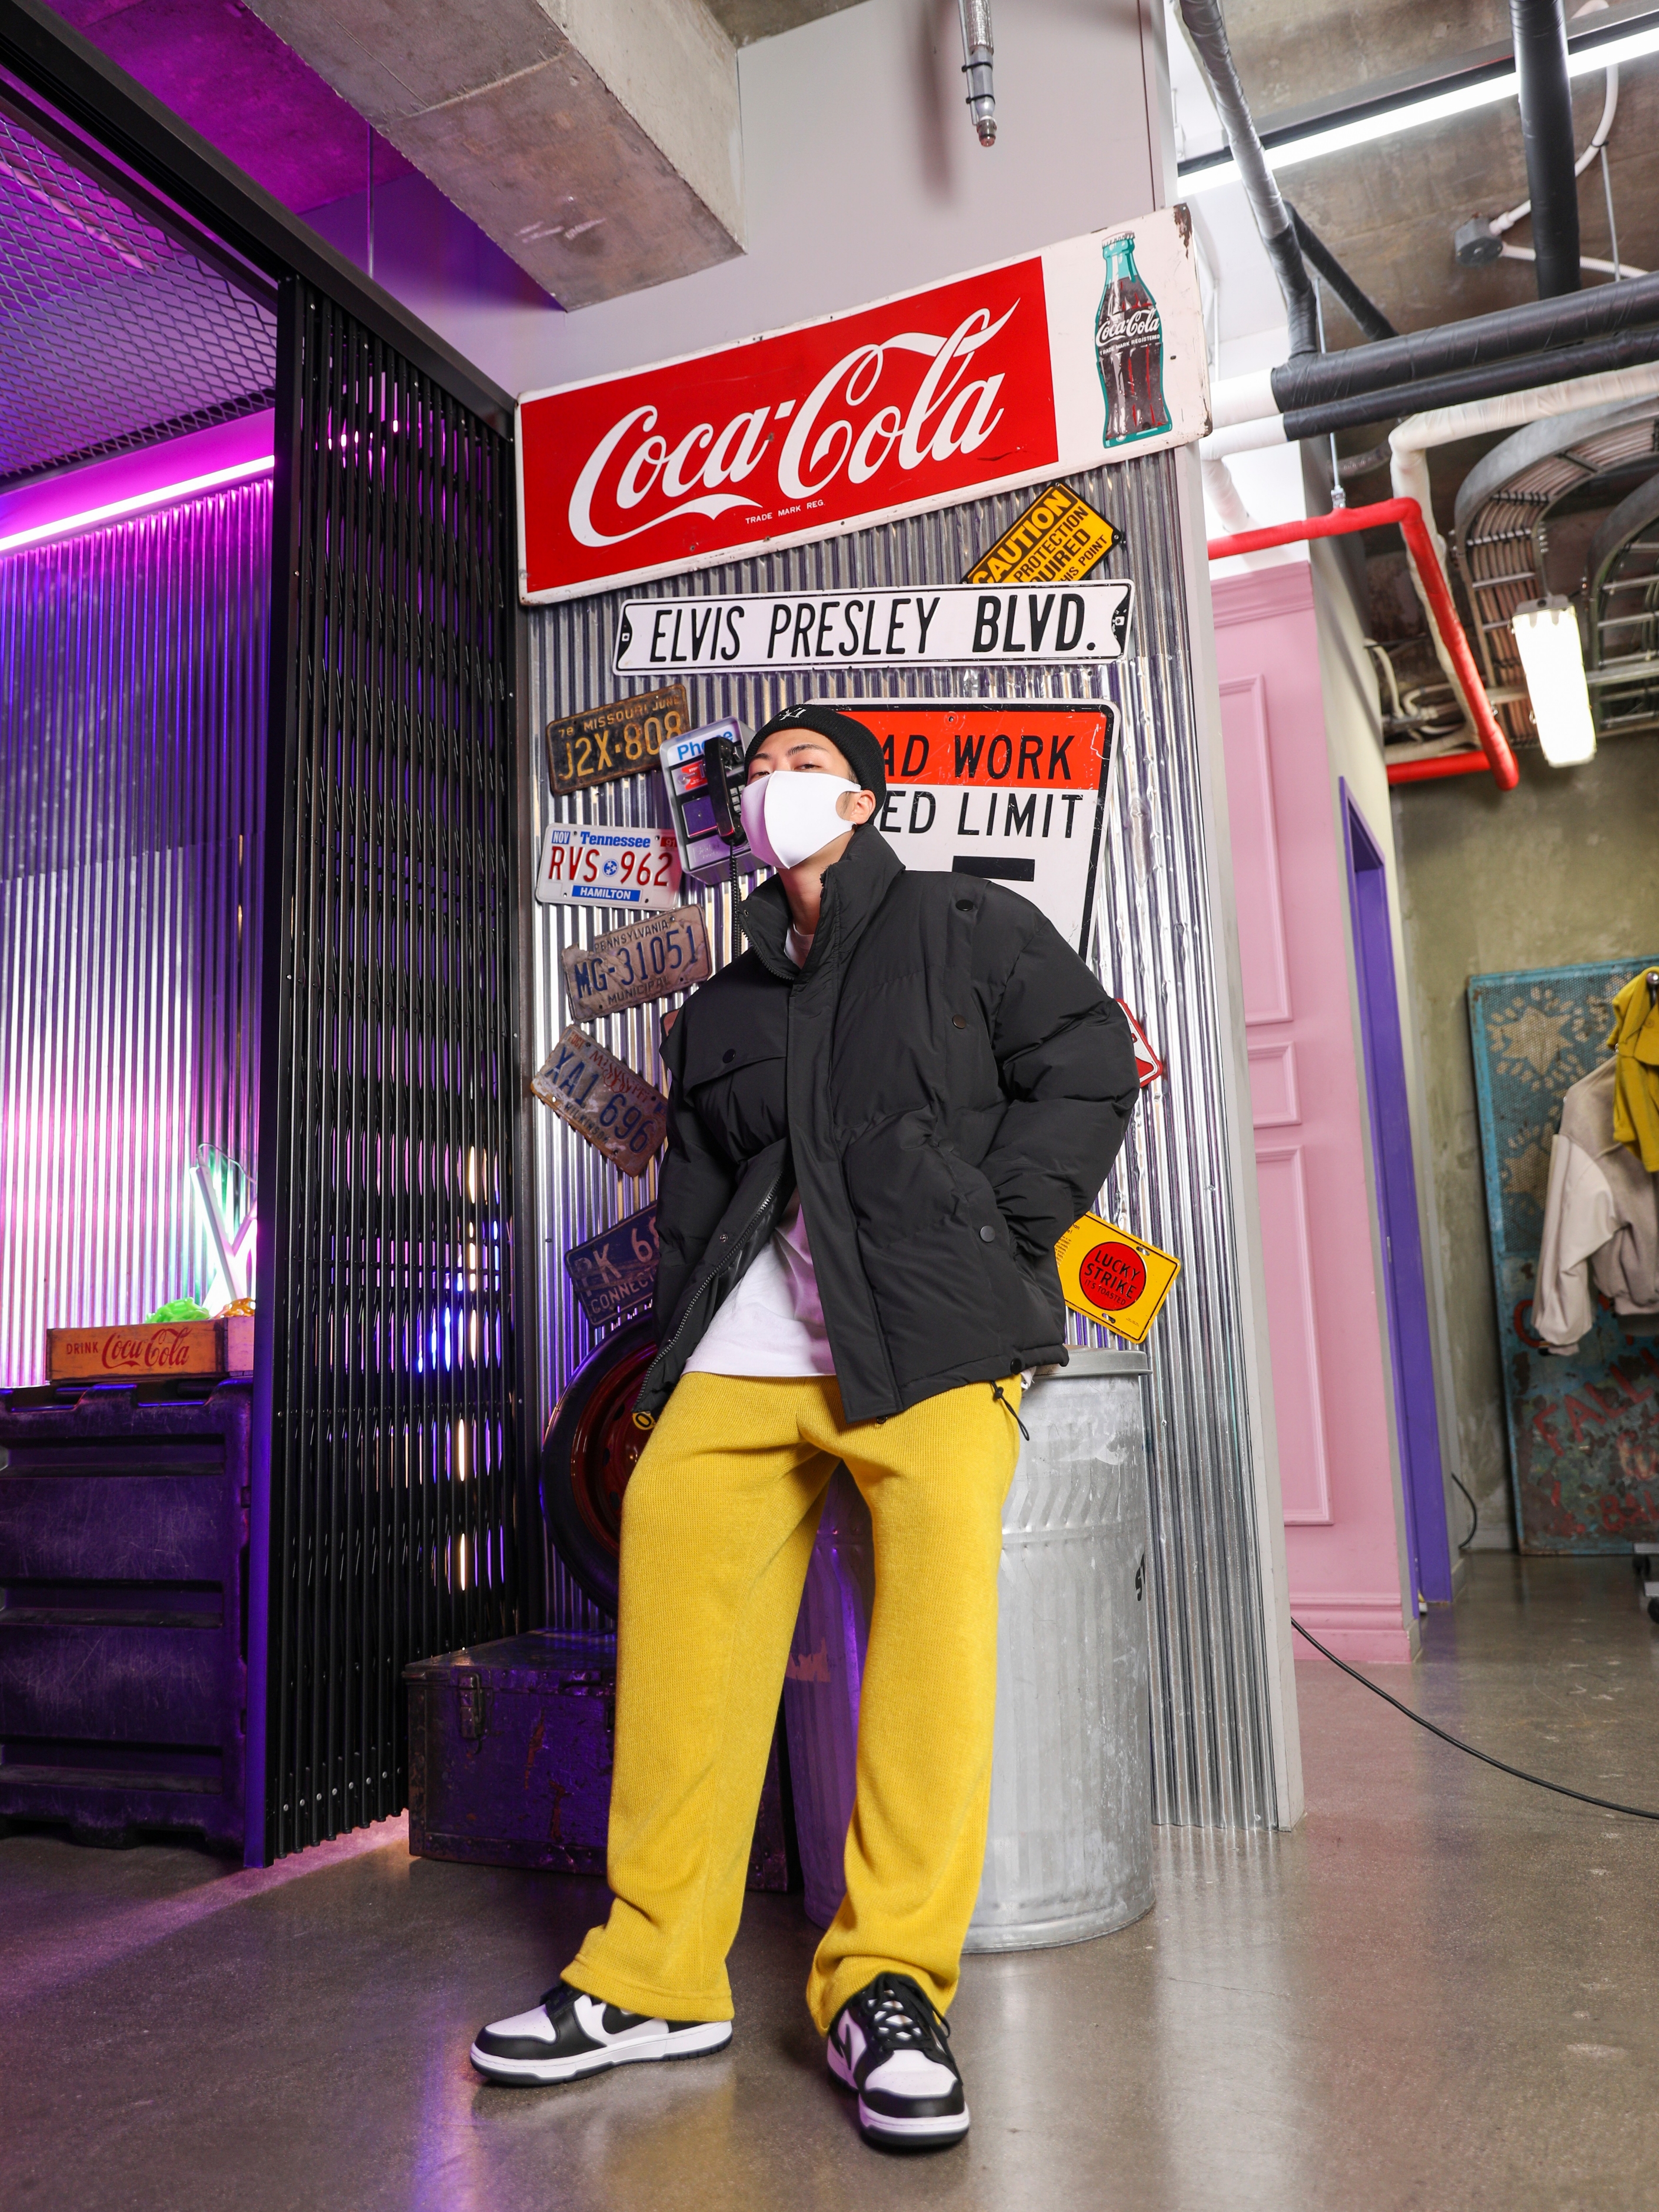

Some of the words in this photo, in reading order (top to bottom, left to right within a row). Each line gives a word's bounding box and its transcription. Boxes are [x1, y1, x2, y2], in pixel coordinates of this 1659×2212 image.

[1095, 307, 1160, 347] Coca-Cola
[1099, 346, 1115, 356] TRADE
[1116, 342, 1130, 350] MARK
[1131, 334, 1160, 345] REGISTERED
[568, 297, 1021, 547] Coca-Cola
[745, 512, 772, 524] TRADE
[778, 505, 801, 517] MARK
[972, 489, 1071, 584] CAUTION
[1013, 505, 1088, 582] PROTECTION
[1059, 567, 1079, 581] HIS
[1078, 534, 1108, 567] POINT
[649, 605, 745, 662] ELVIS
[767, 597, 940, 658] PRESLEY
[972, 593, 1096, 652] BLVD.
[558, 727, 574, 738] 78
[584, 705, 647, 732] MISSOURI
[652, 695, 680, 711] JUNE
[677, 731, 733, 761] Phe
[882, 734, 930, 777] AD
[954, 734, 1075, 780] WORK
[880, 791, 936, 834] ED
[957, 792, 1084, 838] LIMIT
[554, 831, 569, 844] NOV
[580, 831, 651, 848] Tennessee
[549, 845, 601, 882] RVS
[621, 851, 673, 886] 962
[580, 887, 631, 900] HAMILTON
[595, 920, 669, 952] PENNSYLVANIA
[575, 925, 698, 998] MG-31051
[608, 976, 669, 1005] MUNICIPAL
[599, 1093, 654, 1154] 696
[1084, 1263, 1137, 1299] STRIKE
[1094, 1250, 1140, 1281] LUCKY
[1084, 1279, 1097, 1290] IT'S
[1097, 1285, 1126, 1305] TOASTED
[66, 1341, 98, 1355] DRINK
